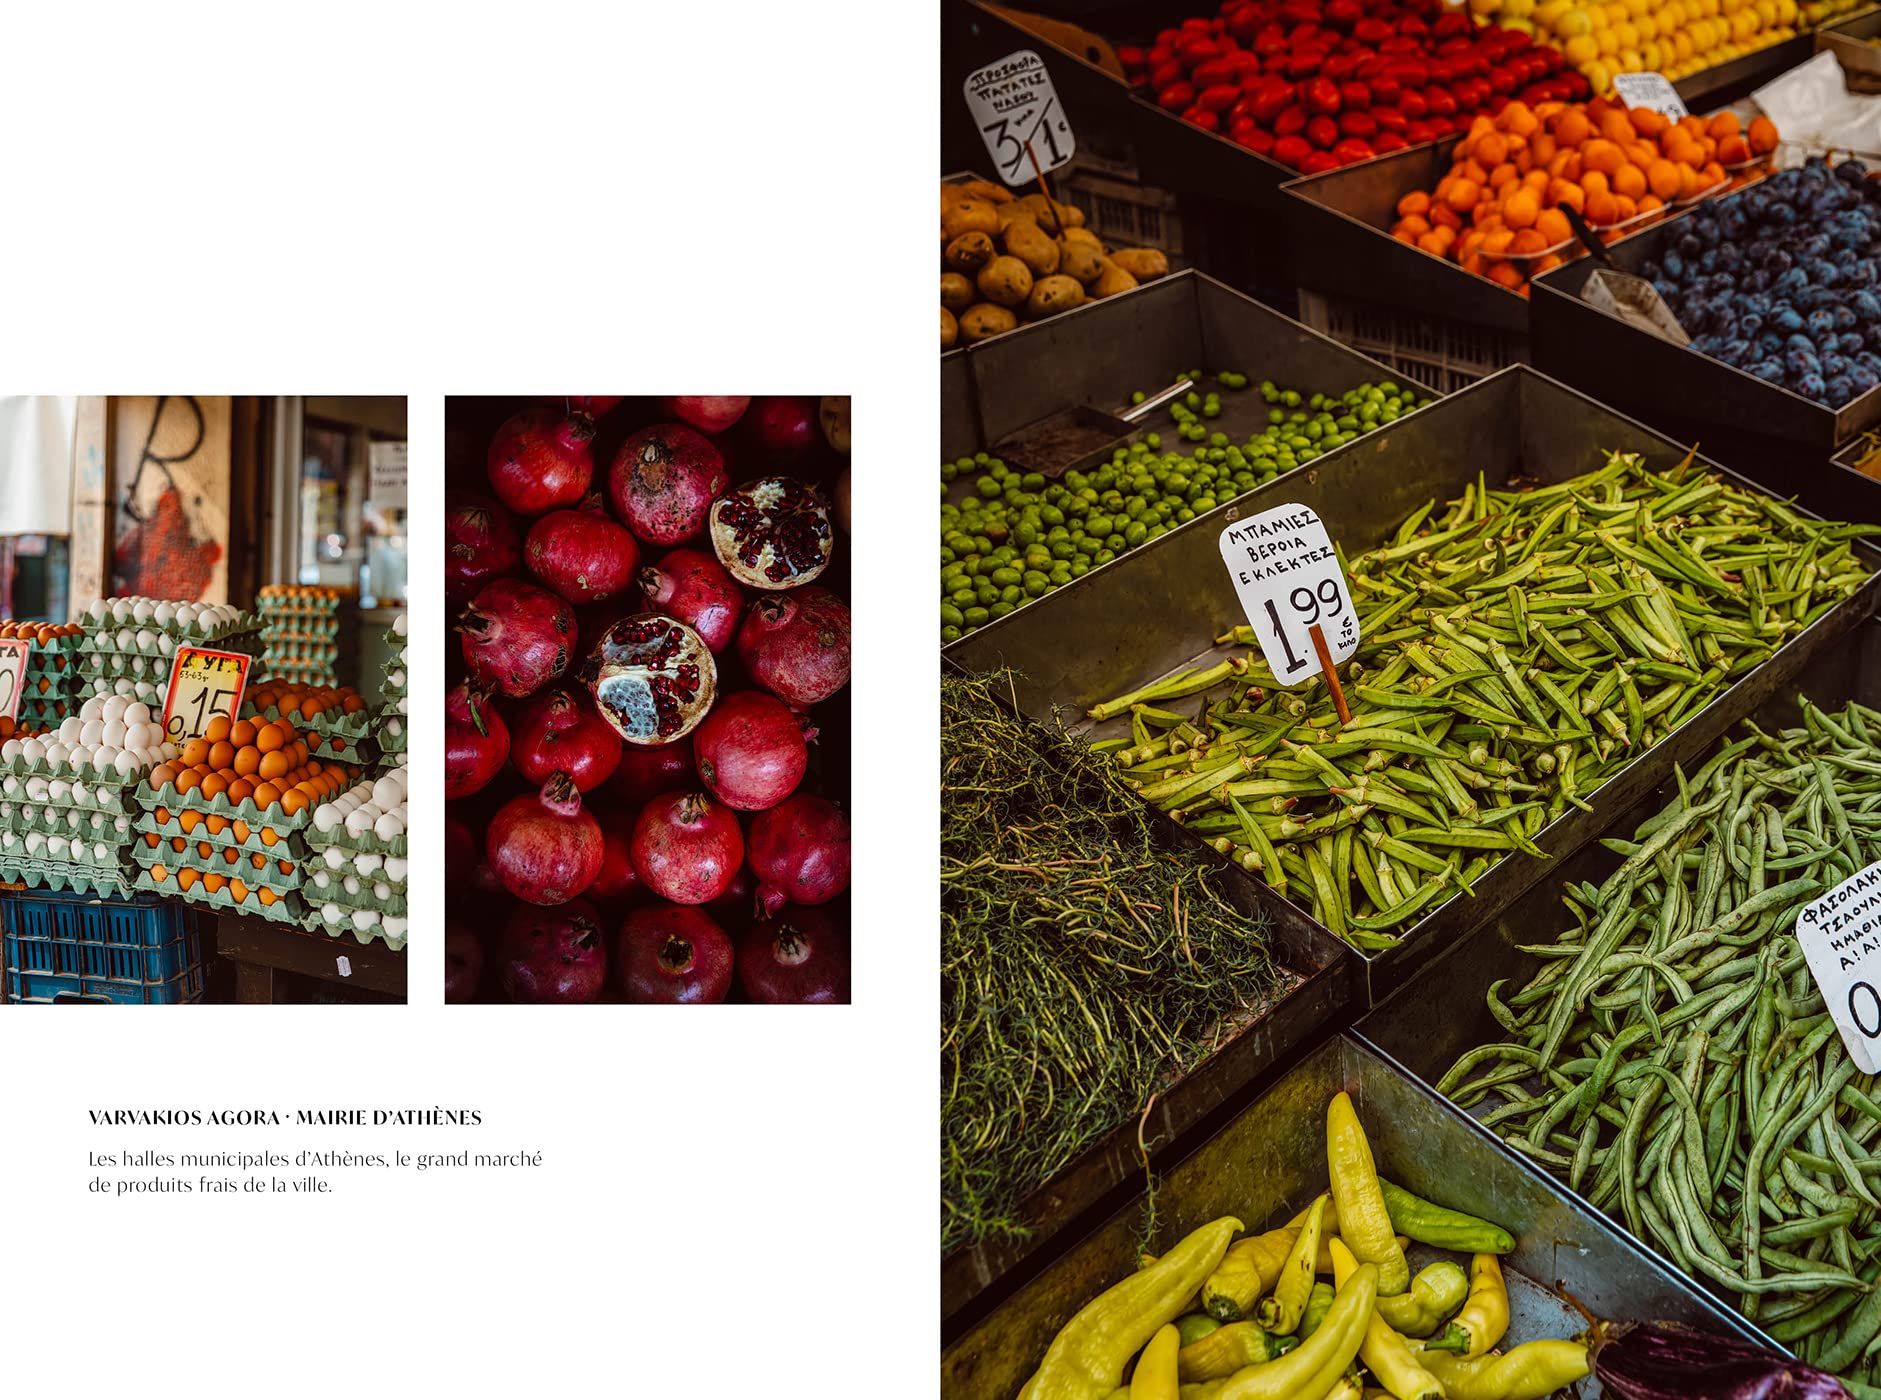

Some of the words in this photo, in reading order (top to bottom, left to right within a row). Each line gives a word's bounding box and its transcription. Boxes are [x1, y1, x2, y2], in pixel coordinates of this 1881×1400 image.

[977, 72, 1046, 101] ΠΑΤΑΤΕΣ
[1228, 510, 1319, 545] ΜΠΑΜΙΕΣ
[1246, 536, 1307, 563] ΒΕΡΟΙΑ
